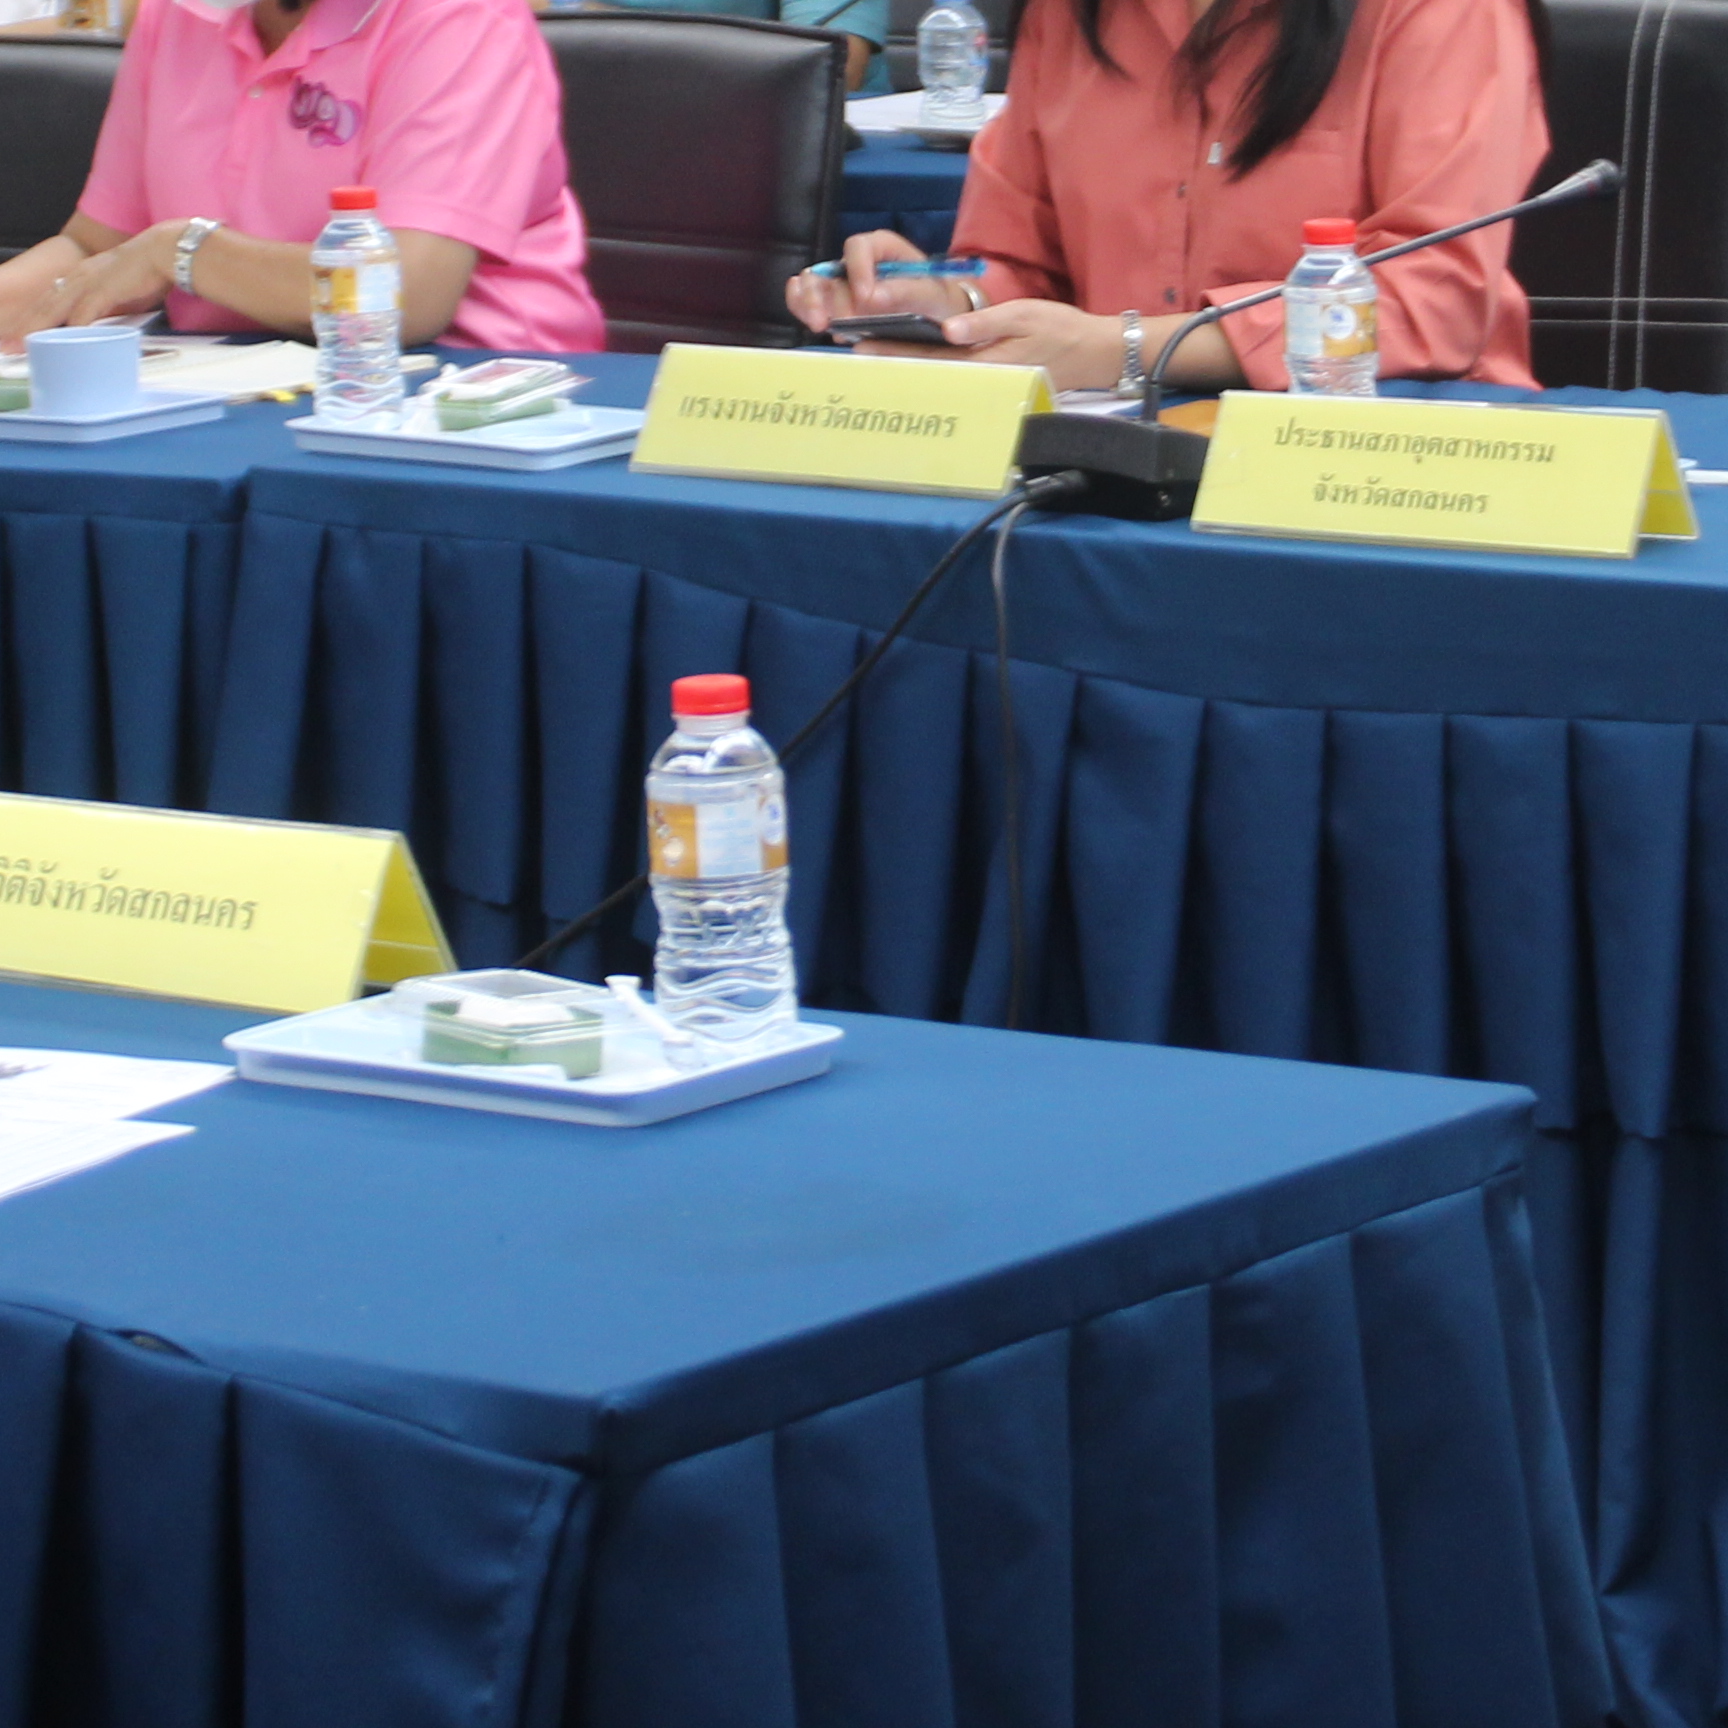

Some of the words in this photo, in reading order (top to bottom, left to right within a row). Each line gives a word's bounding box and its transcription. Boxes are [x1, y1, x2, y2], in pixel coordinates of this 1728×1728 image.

[678, 390, 960, 438] แรงงานจังหวัดสกลนคร
[1274, 417, 1556, 464] ประธานสภาอุตสาหกรรม
[1312, 473, 1489, 514] จังหวัดสกลนคร
